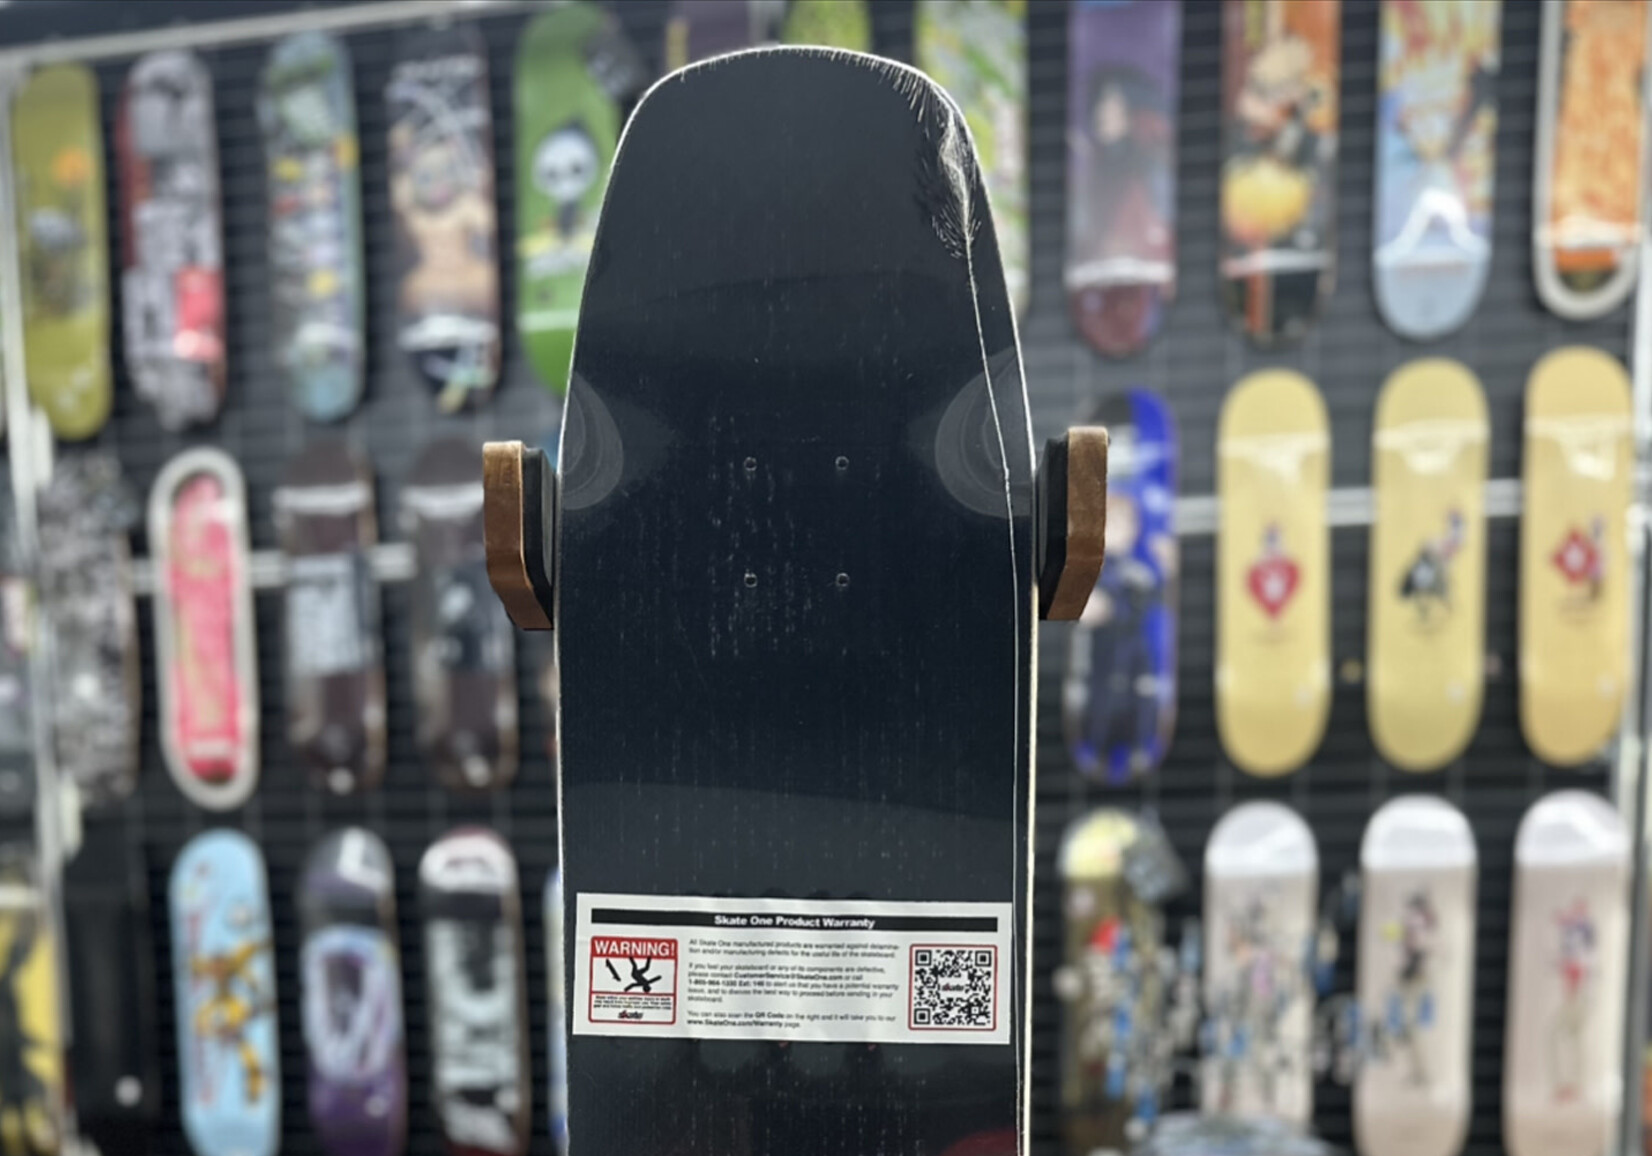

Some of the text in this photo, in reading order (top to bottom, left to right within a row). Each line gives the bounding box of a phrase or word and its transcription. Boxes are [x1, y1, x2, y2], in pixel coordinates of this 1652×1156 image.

[714, 915, 876, 929] Skate One Product Warranty
[594, 940, 675, 957] WARNING!
